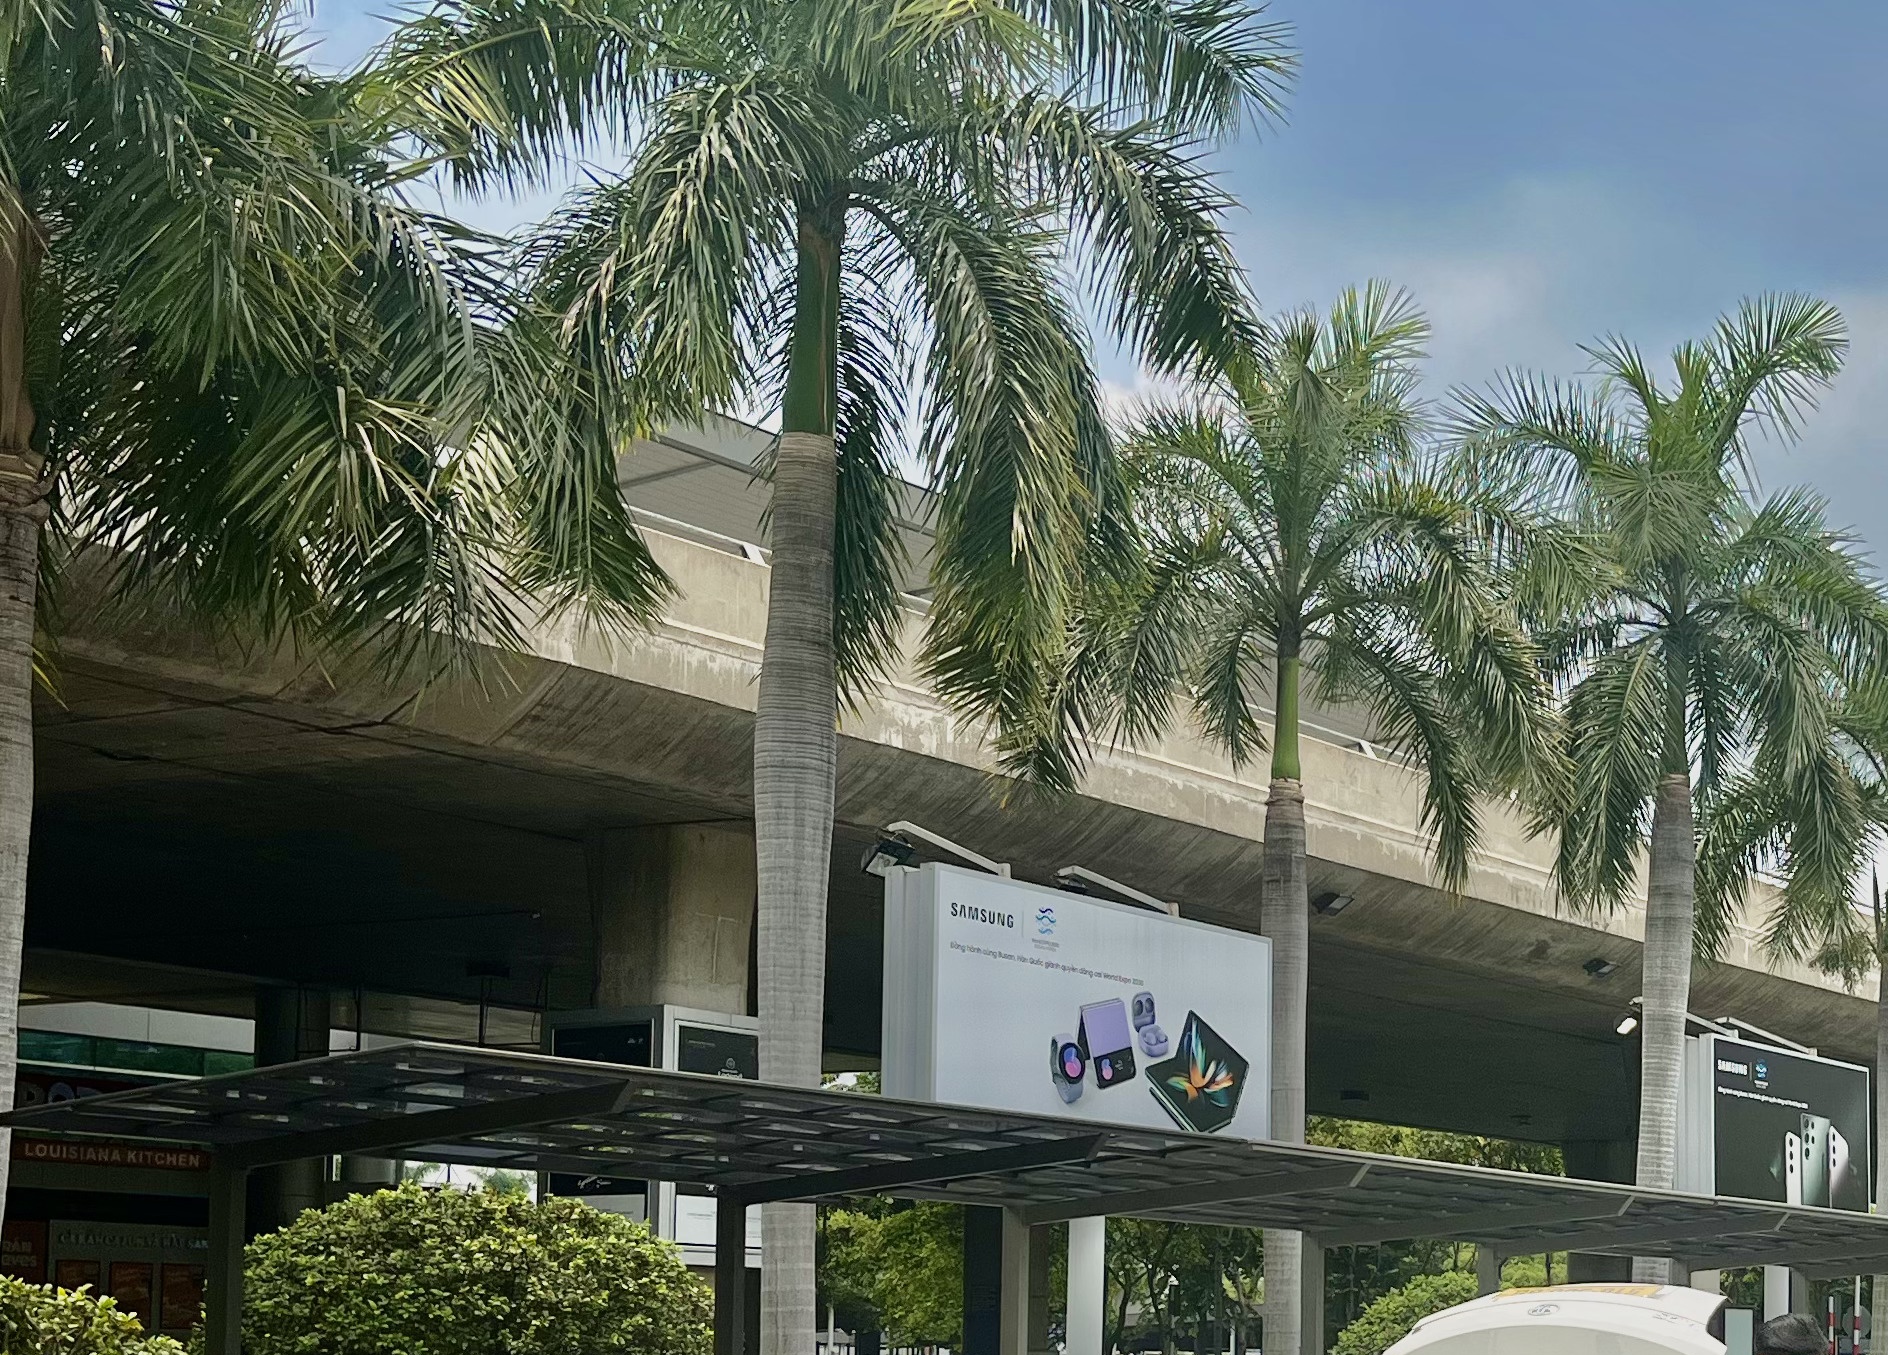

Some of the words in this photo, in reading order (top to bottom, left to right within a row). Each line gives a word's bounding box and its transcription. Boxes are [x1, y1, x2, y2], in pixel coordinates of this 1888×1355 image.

[951, 902, 1014, 929] SAMSUNG
[25, 1143, 122, 1163] LOUISIANA
[127, 1151, 201, 1168] KITCHEN
